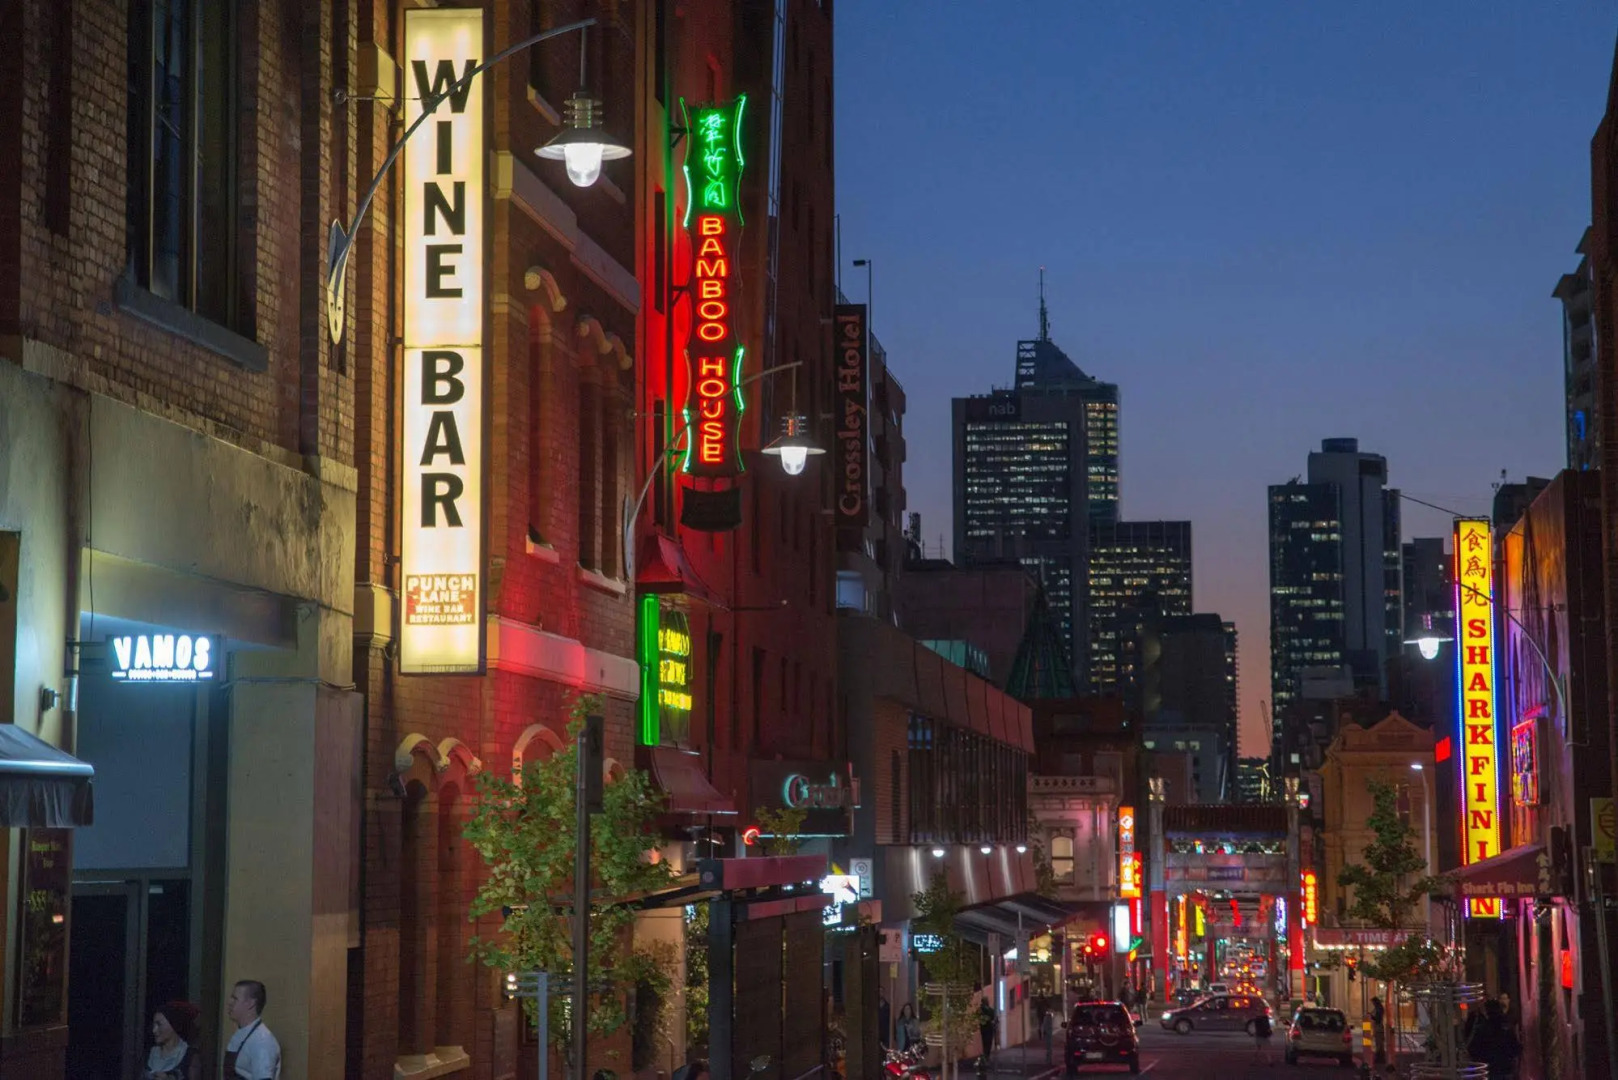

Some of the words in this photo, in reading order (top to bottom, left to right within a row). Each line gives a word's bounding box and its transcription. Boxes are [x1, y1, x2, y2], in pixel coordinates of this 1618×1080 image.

[411, 59, 478, 298] WINE
[695, 217, 727, 341] BAMBOO
[837, 313, 861, 393] Hotel
[419, 350, 466, 528] BAR
[700, 358, 725, 463] HOUSE
[988, 401, 1016, 415] nab
[838, 398, 867, 517] Crossley
[407, 576, 473, 592] PUNCH
[420, 591, 459, 602] LANE
[113, 634, 210, 671] VAMOS
[1466, 618, 1493, 745] SHARK
[1470, 756, 1493, 830] FIN
[1462, 881, 1495, 895] Shark
[1497, 881, 1515, 895] Fin
[1517, 882, 1535, 894] Inn
[1356, 932, 1389, 942] TIME
